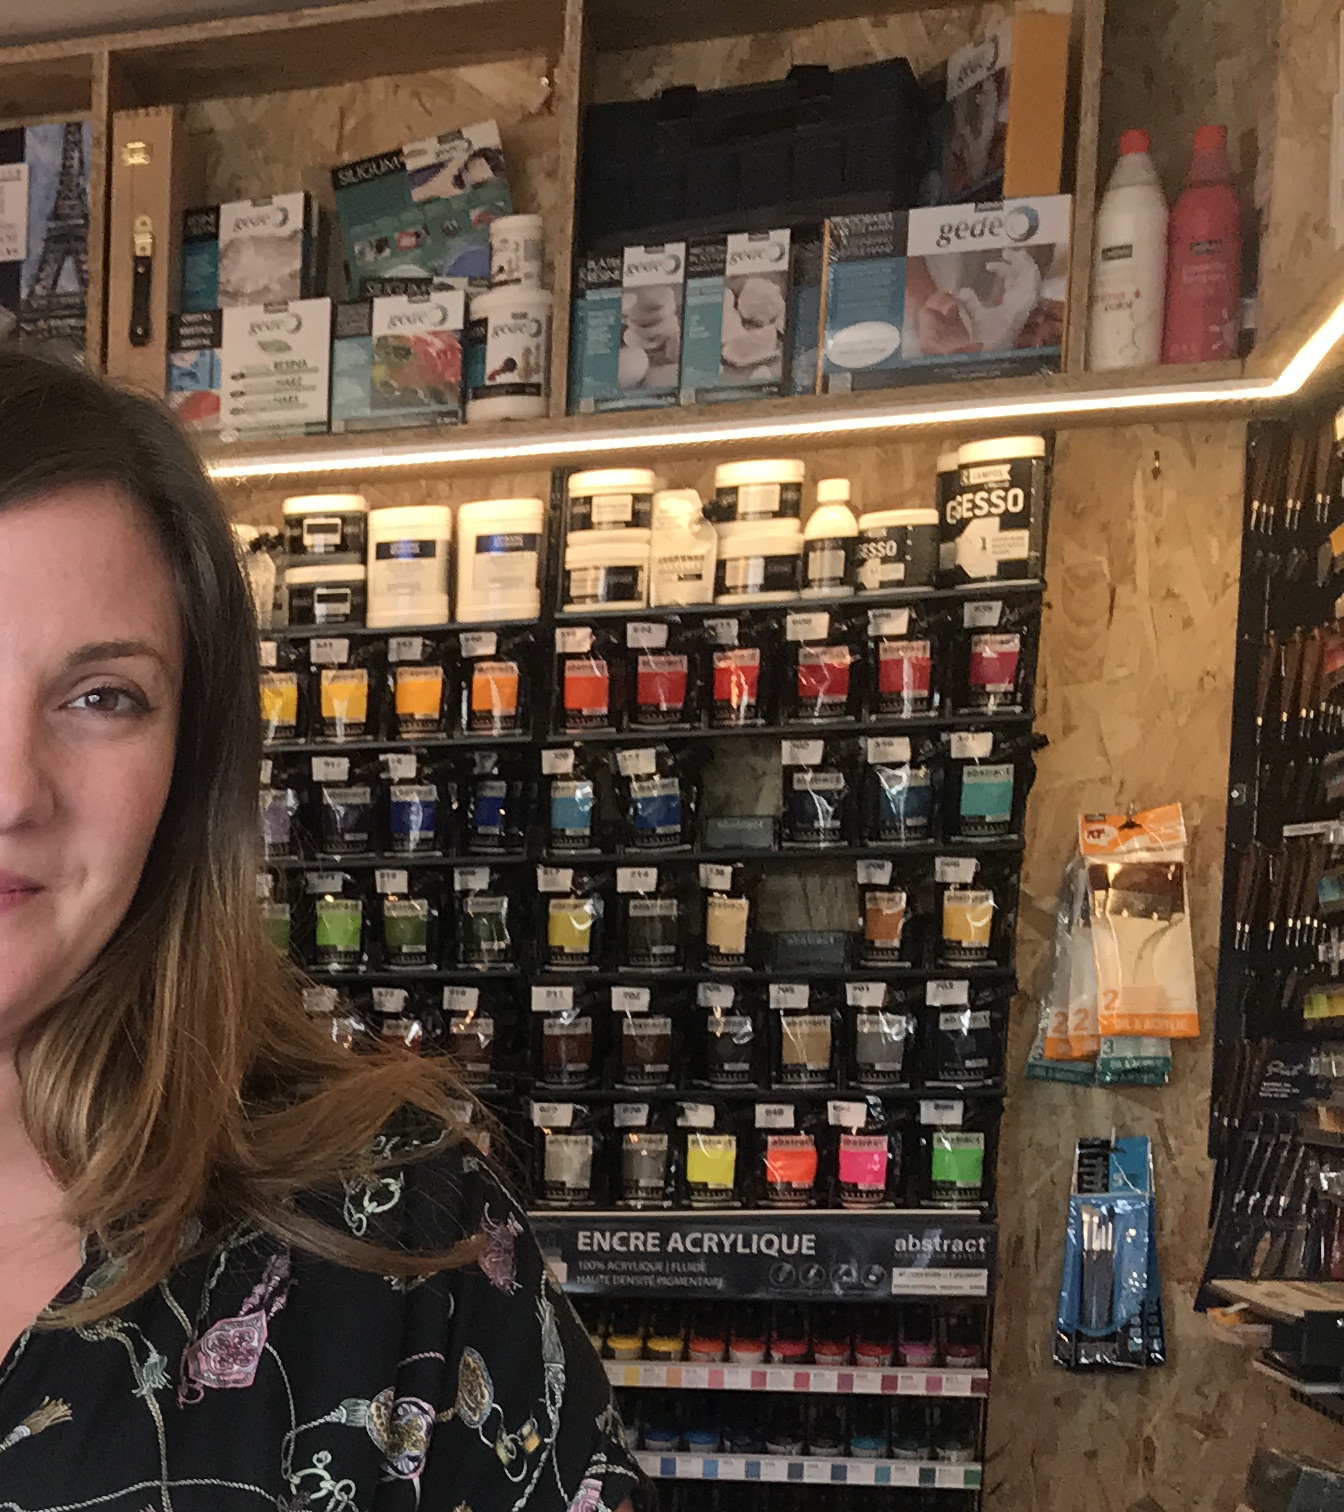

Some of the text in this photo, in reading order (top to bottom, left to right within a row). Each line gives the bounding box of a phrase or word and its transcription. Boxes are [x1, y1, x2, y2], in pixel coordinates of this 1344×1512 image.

[576, 1230, 817, 1257] ENCRE ACRYLIQUE
[894, 1233, 987, 1253] abstract
